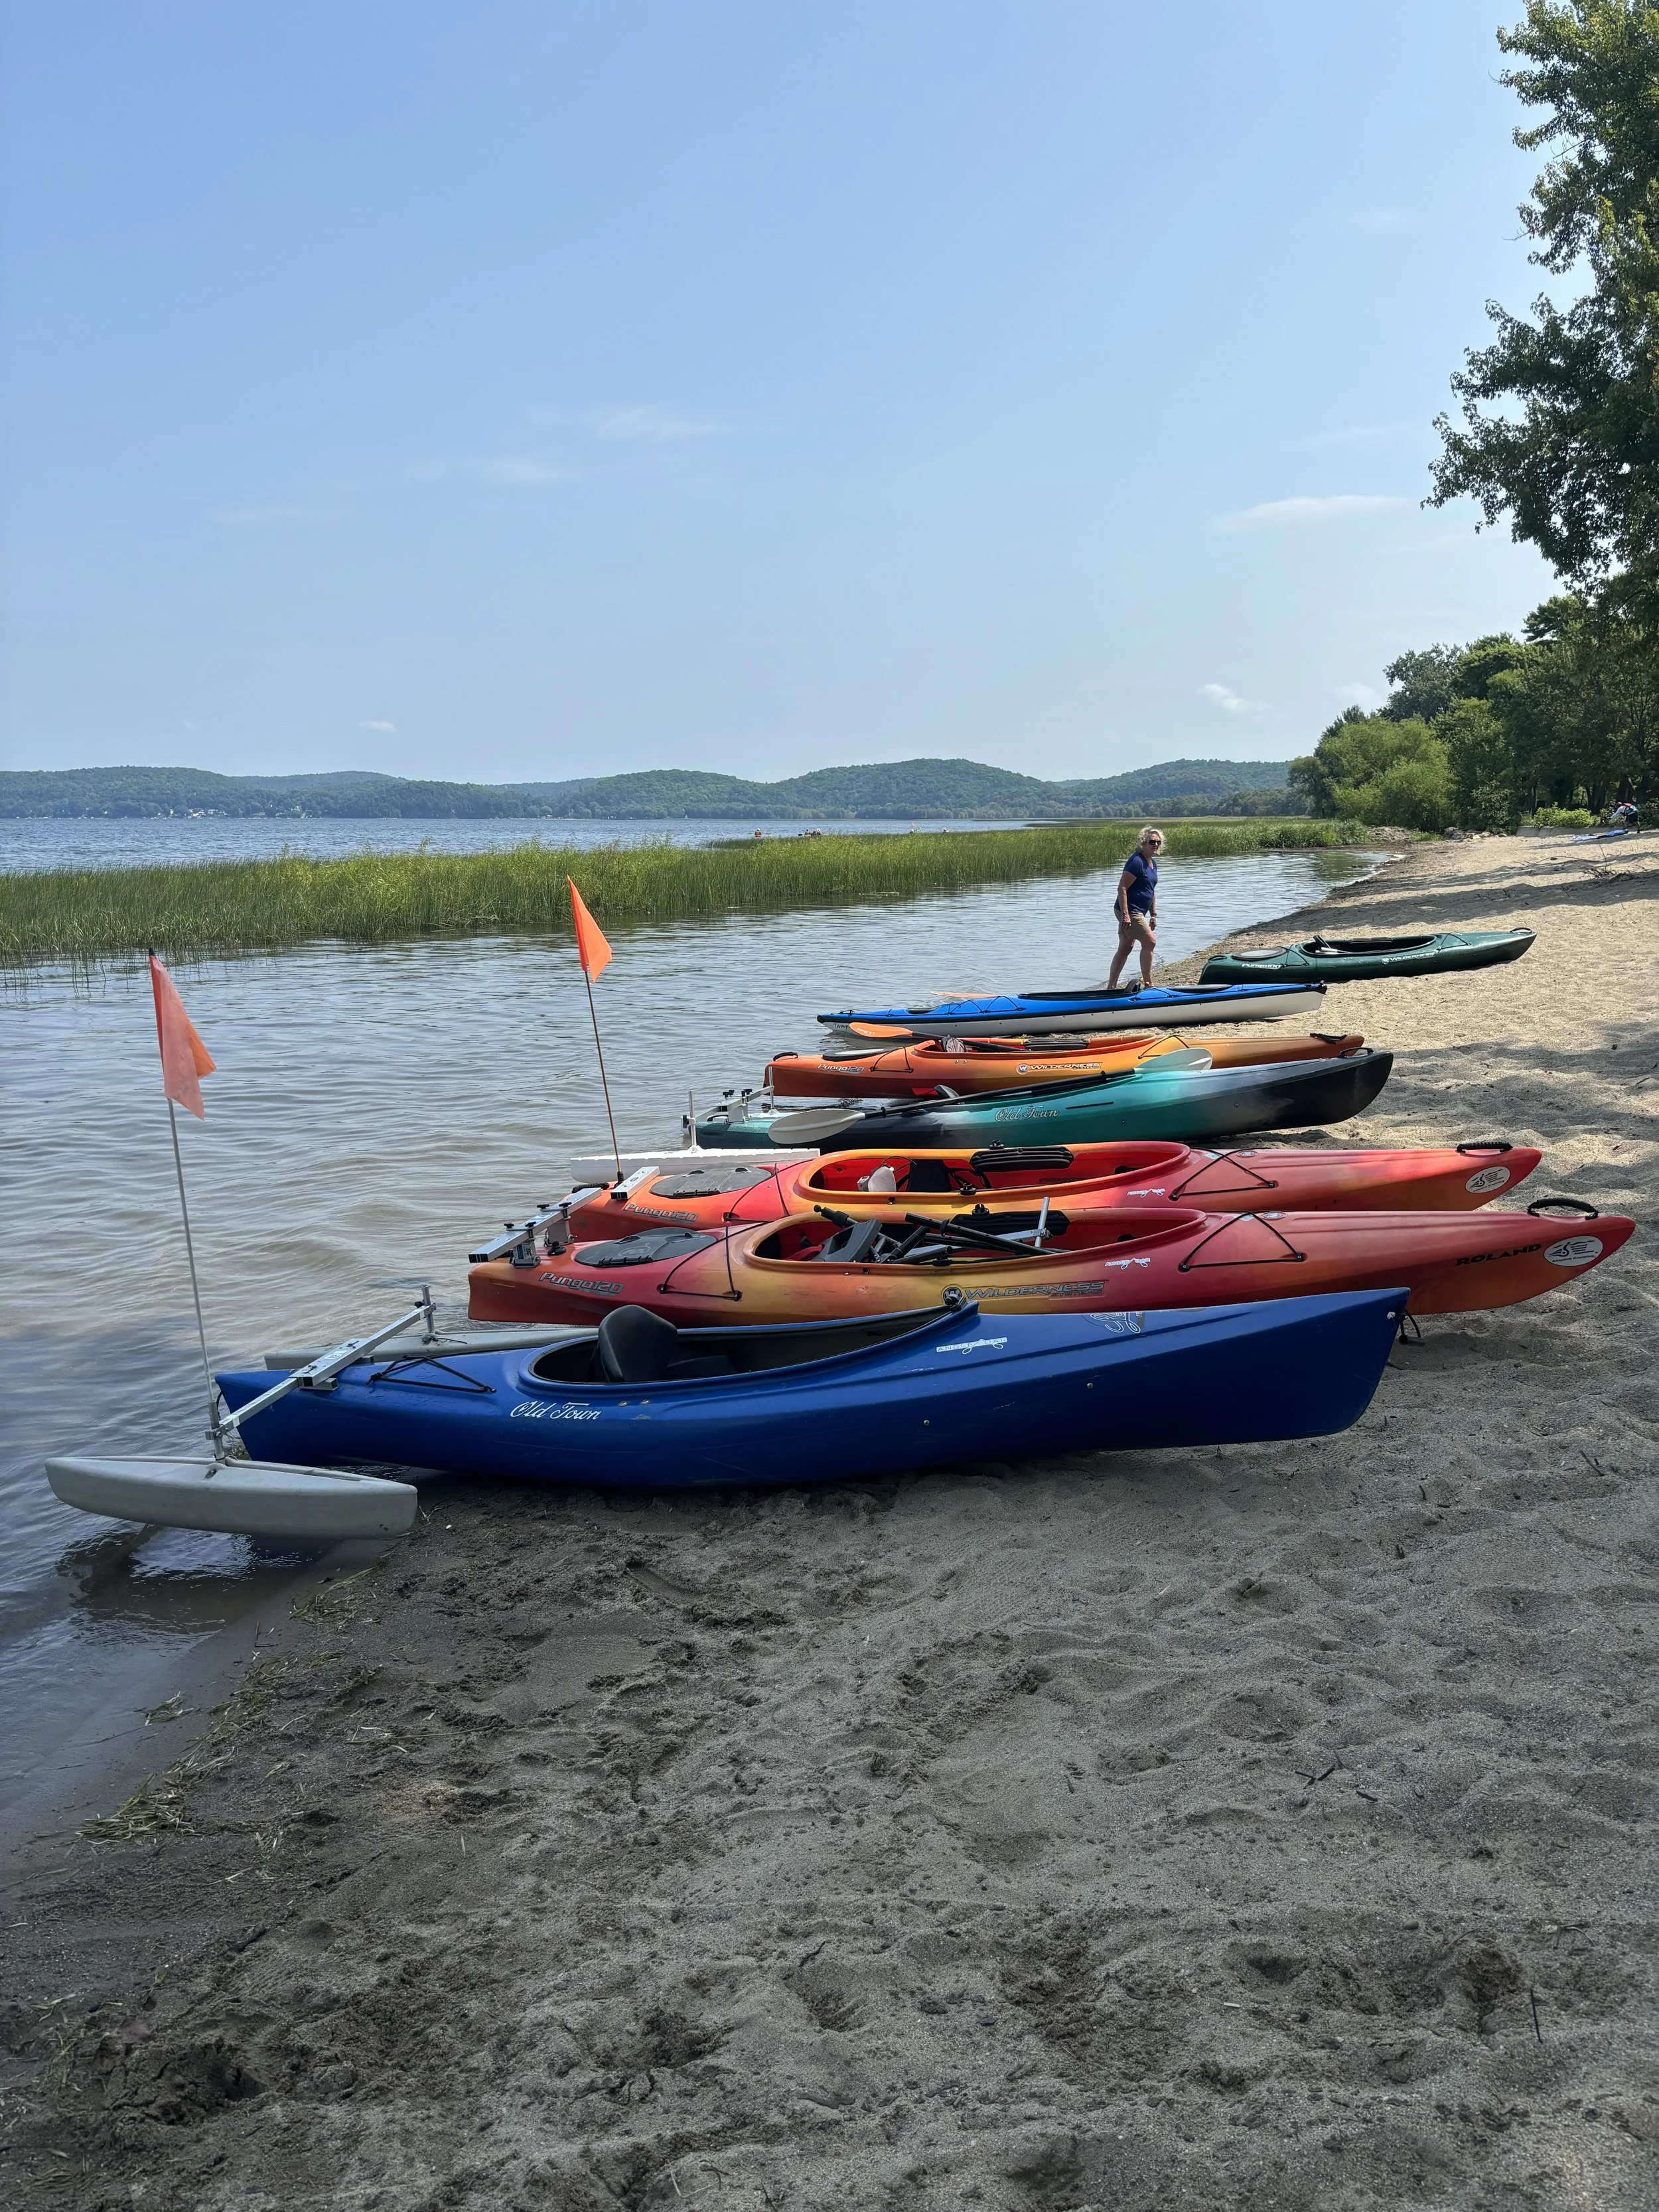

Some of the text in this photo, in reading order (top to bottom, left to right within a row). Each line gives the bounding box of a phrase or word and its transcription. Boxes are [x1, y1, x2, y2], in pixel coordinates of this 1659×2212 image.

[995, 1105, 1059, 1122] Old Town
[624, 1203, 699, 1222] Pungo120
[1456, 1244, 1542, 1266] ROLAND
[538, 1272, 624, 1294] Pungo120
[965, 1282, 1105, 1299] WILDERNESS
[510, 1400, 602, 1420] Old Town
